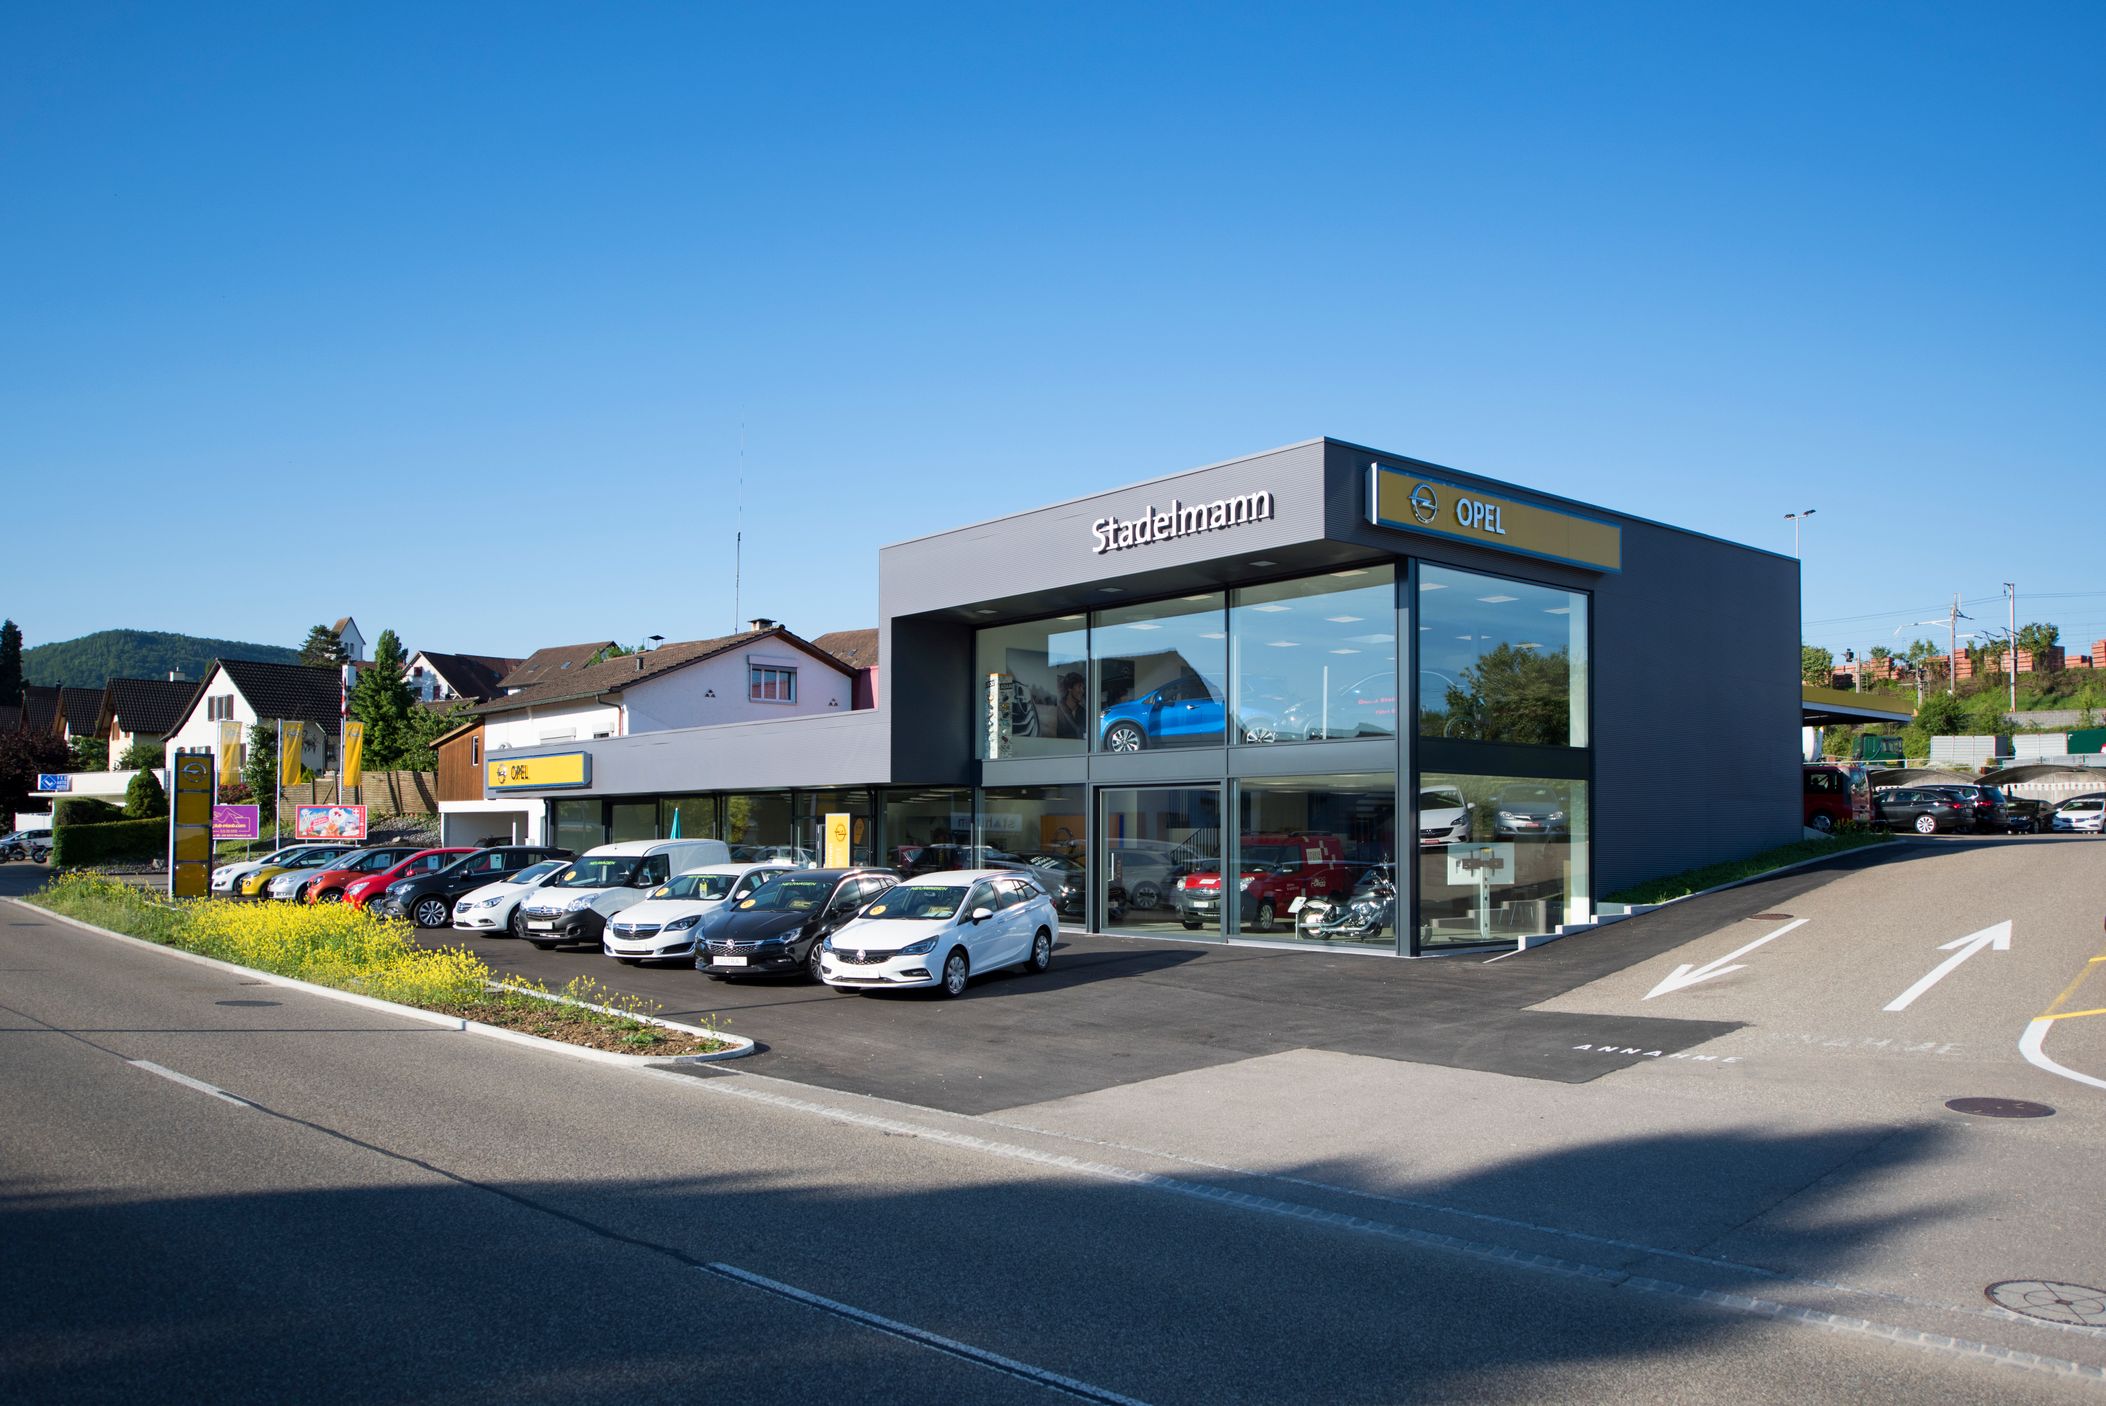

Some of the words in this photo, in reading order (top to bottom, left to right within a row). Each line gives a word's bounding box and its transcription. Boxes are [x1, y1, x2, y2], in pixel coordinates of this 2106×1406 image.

[1092, 490, 1272, 553] Stadelmann
[1456, 497, 1506, 535] OPEL
[511, 765, 529, 780] OPEL
[1572, 1044, 1744, 1063] ANNAHME
